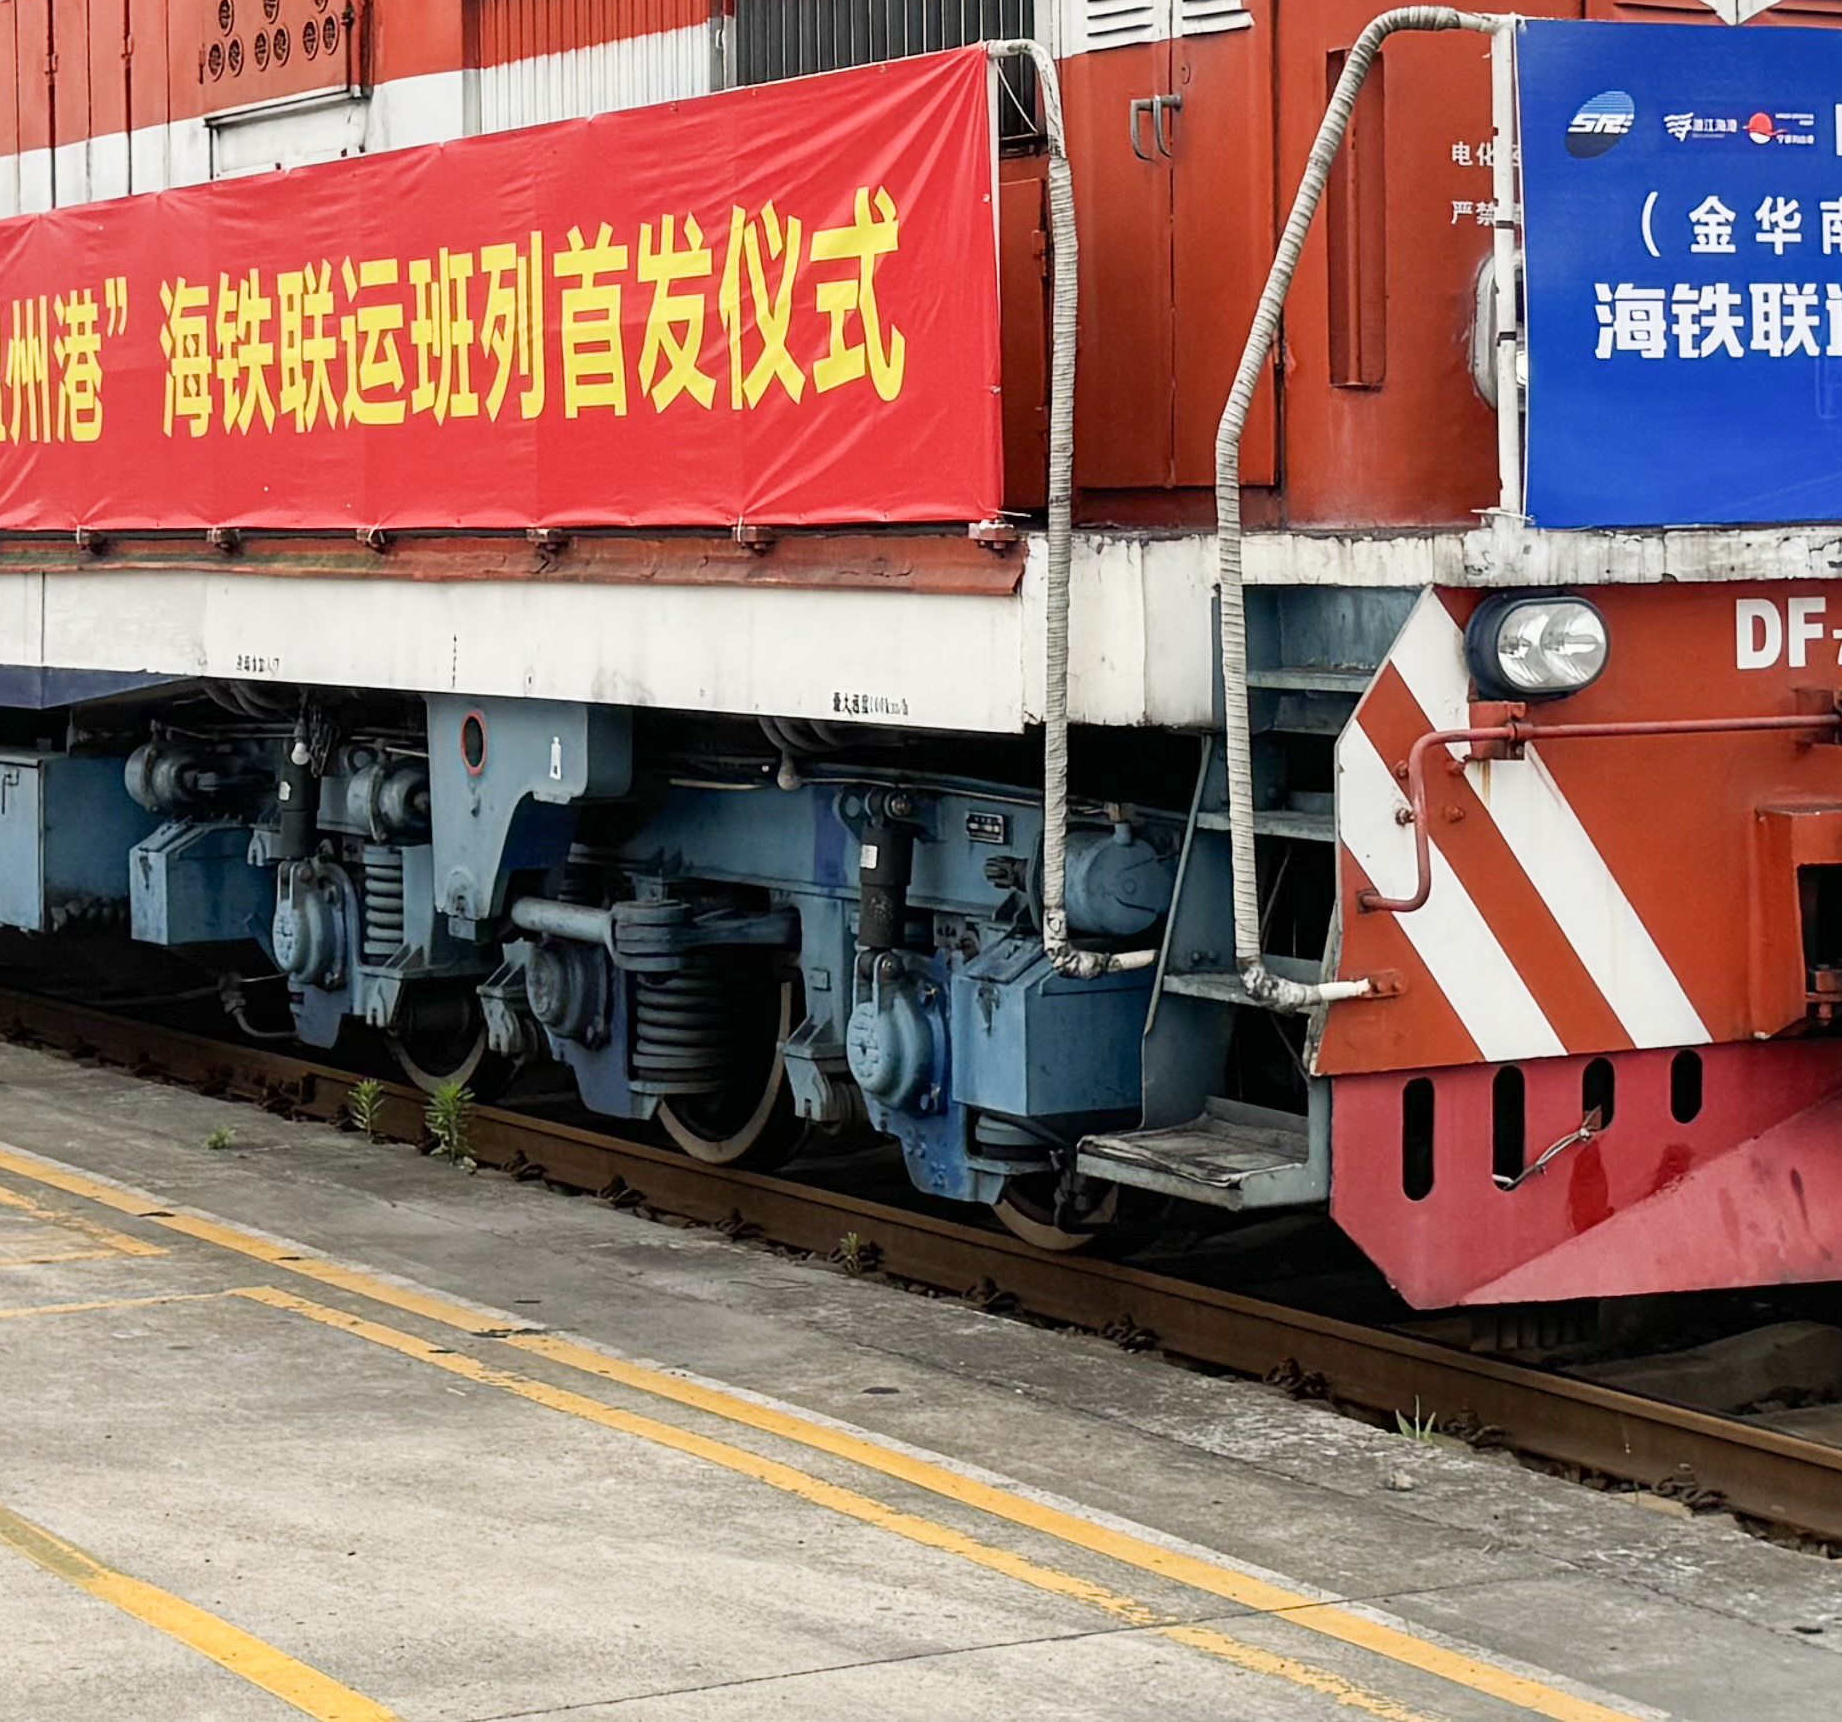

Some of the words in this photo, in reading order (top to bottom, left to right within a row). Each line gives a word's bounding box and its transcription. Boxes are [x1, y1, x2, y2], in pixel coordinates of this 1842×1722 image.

[159, 185, 907, 439] 海铁联运班列首发仪式
